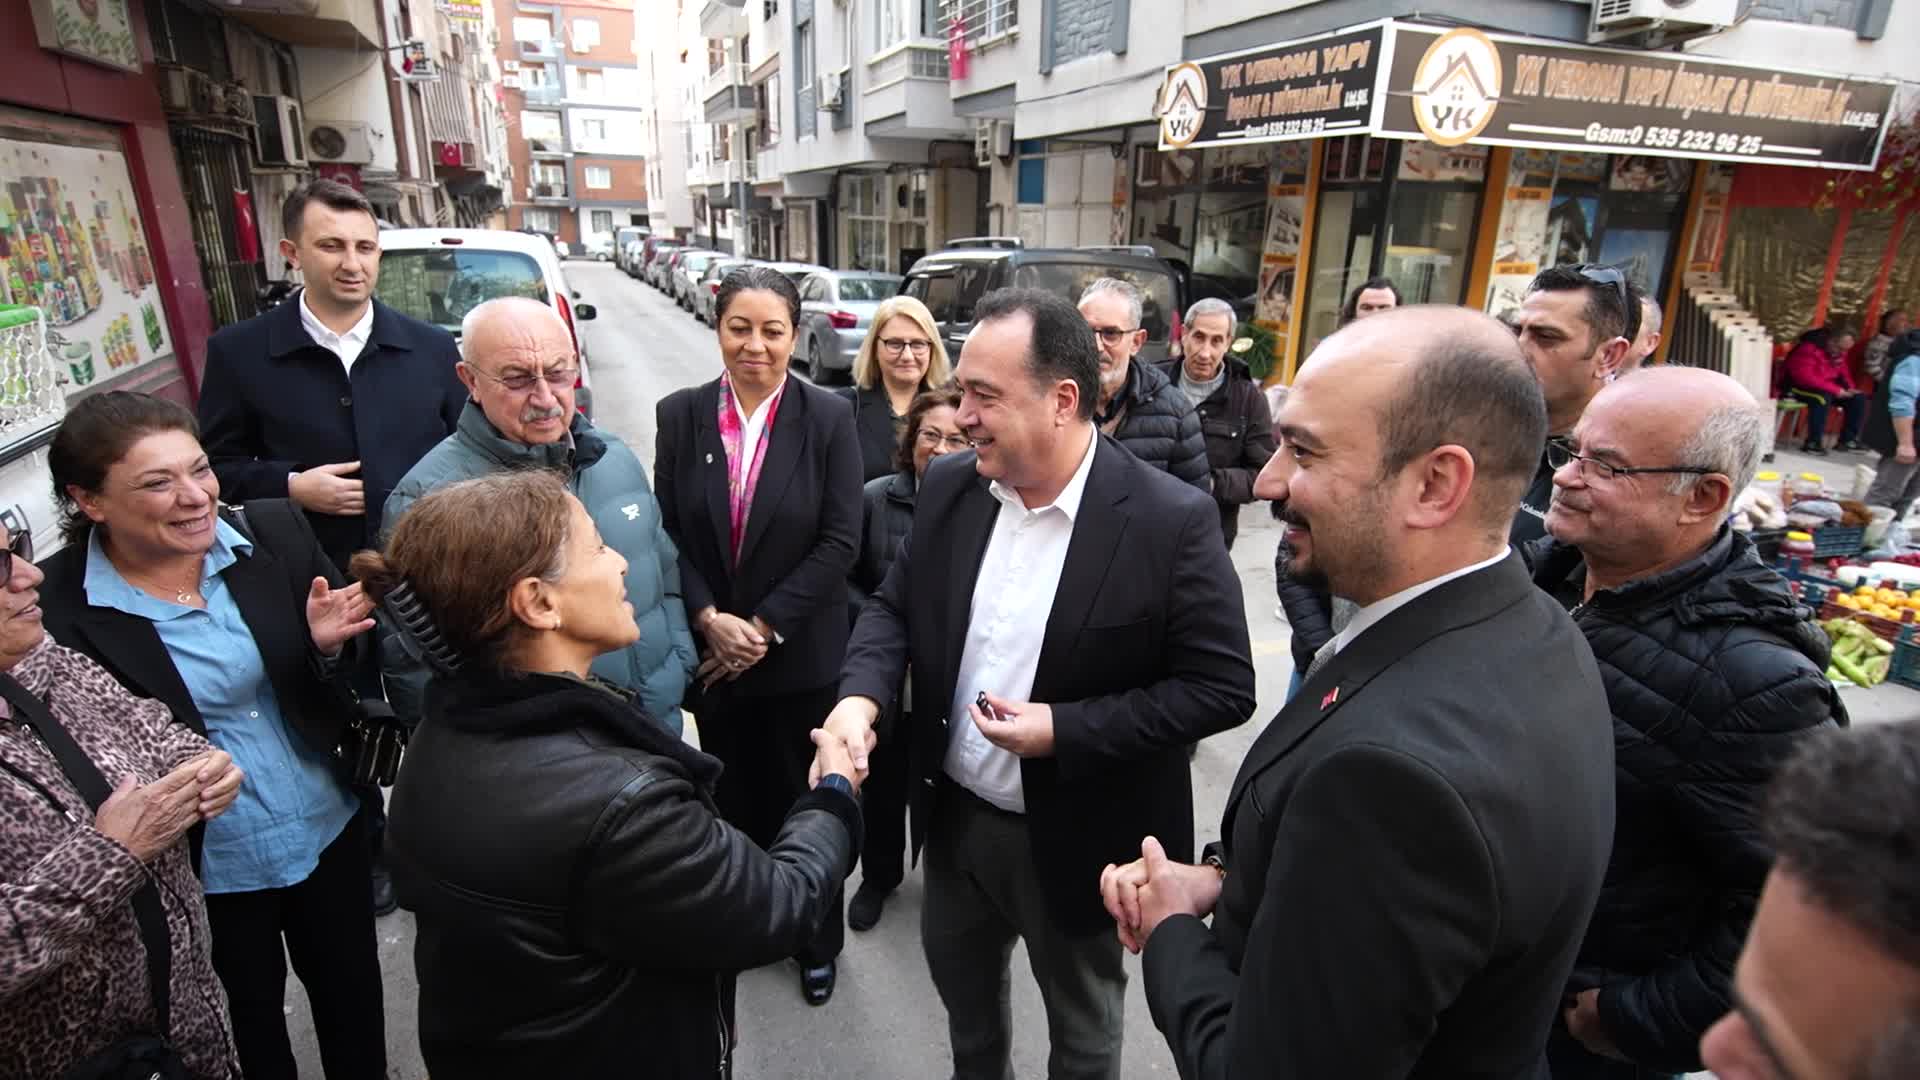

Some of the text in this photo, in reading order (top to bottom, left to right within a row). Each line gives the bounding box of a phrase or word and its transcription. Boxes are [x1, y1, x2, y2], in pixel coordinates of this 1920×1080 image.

[1220, 39, 1371, 90] YK VERONA YAPI
[1512, 53, 1547, 97] YK
[1544, 57, 1625, 105] VERONA
[1624, 63, 1673, 109] YAPI
[1727, 78, 1749, 116] &
[1260, 92, 1271, 117] &
[1431, 104, 1476, 131] YK
[1170, 118, 1193, 137] YK
[1644, 126, 1681, 148] 535
[1679, 129, 1715, 150] 232
[1714, 132, 1739, 153] 96
[1737, 135, 1763, 154] 25
